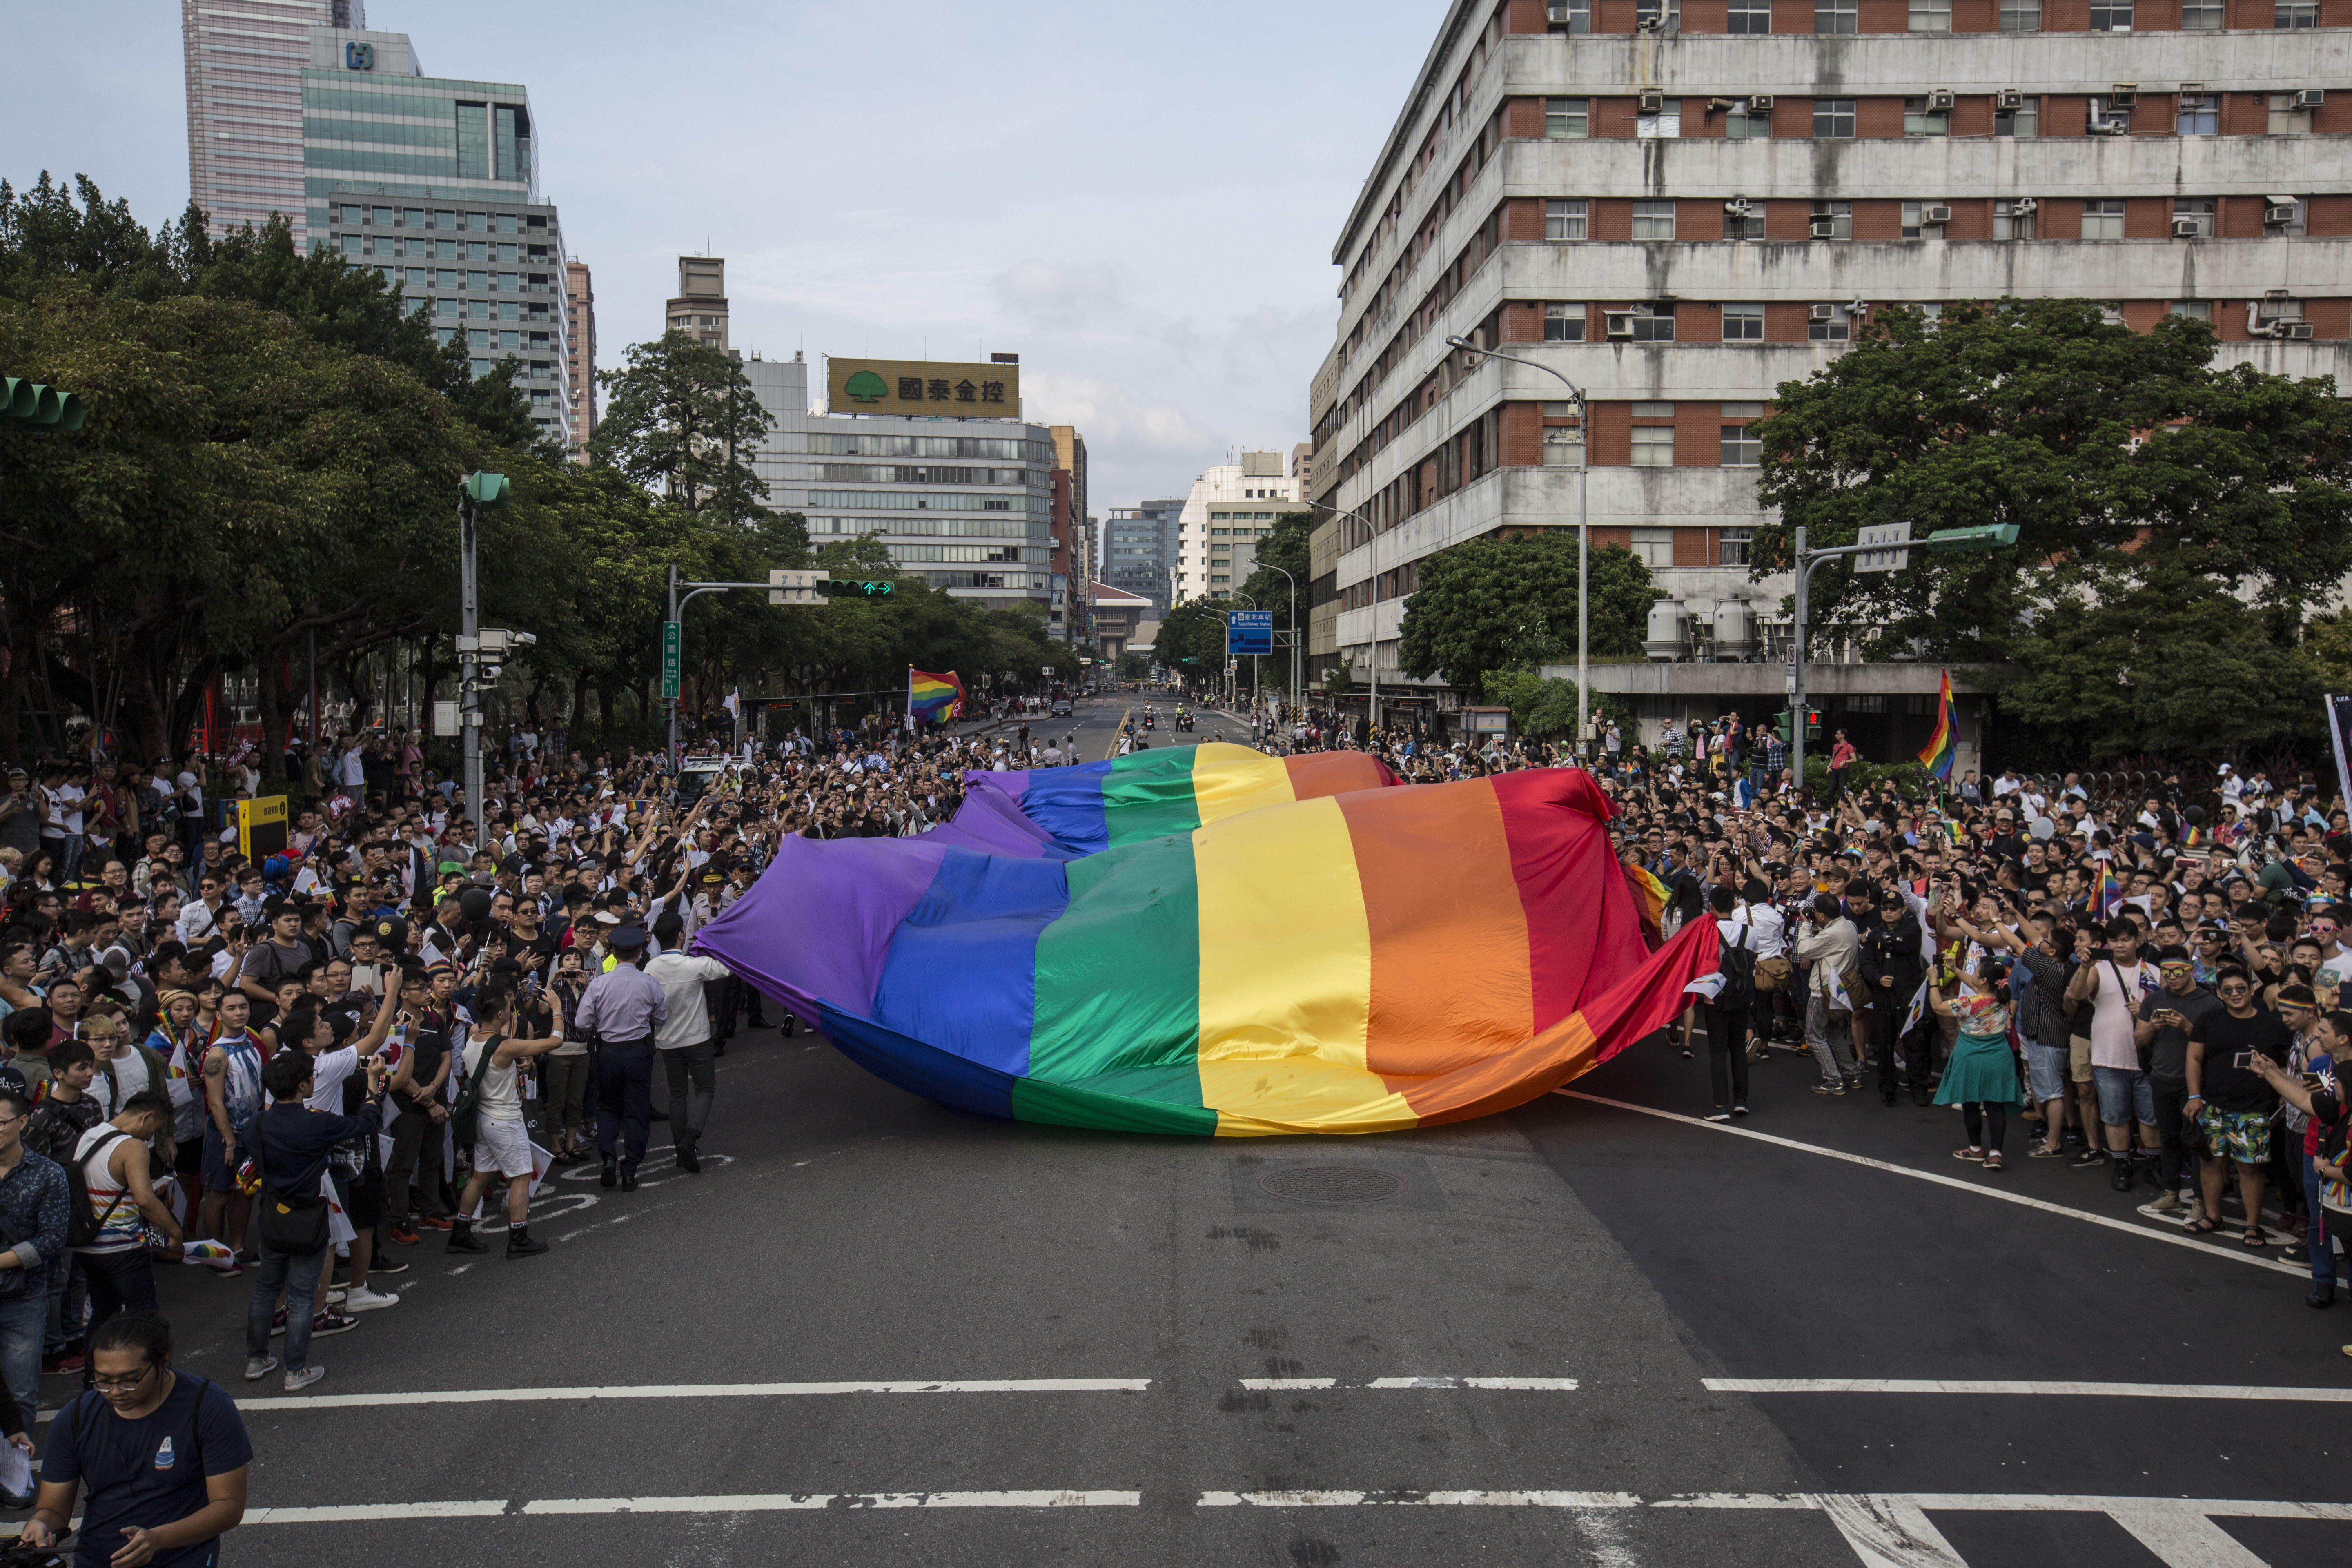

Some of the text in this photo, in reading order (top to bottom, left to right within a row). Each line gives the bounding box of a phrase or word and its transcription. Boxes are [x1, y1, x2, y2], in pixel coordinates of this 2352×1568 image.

[898, 377, 1004, 402] 國泰金控
[668, 631, 676, 666] 公園路
